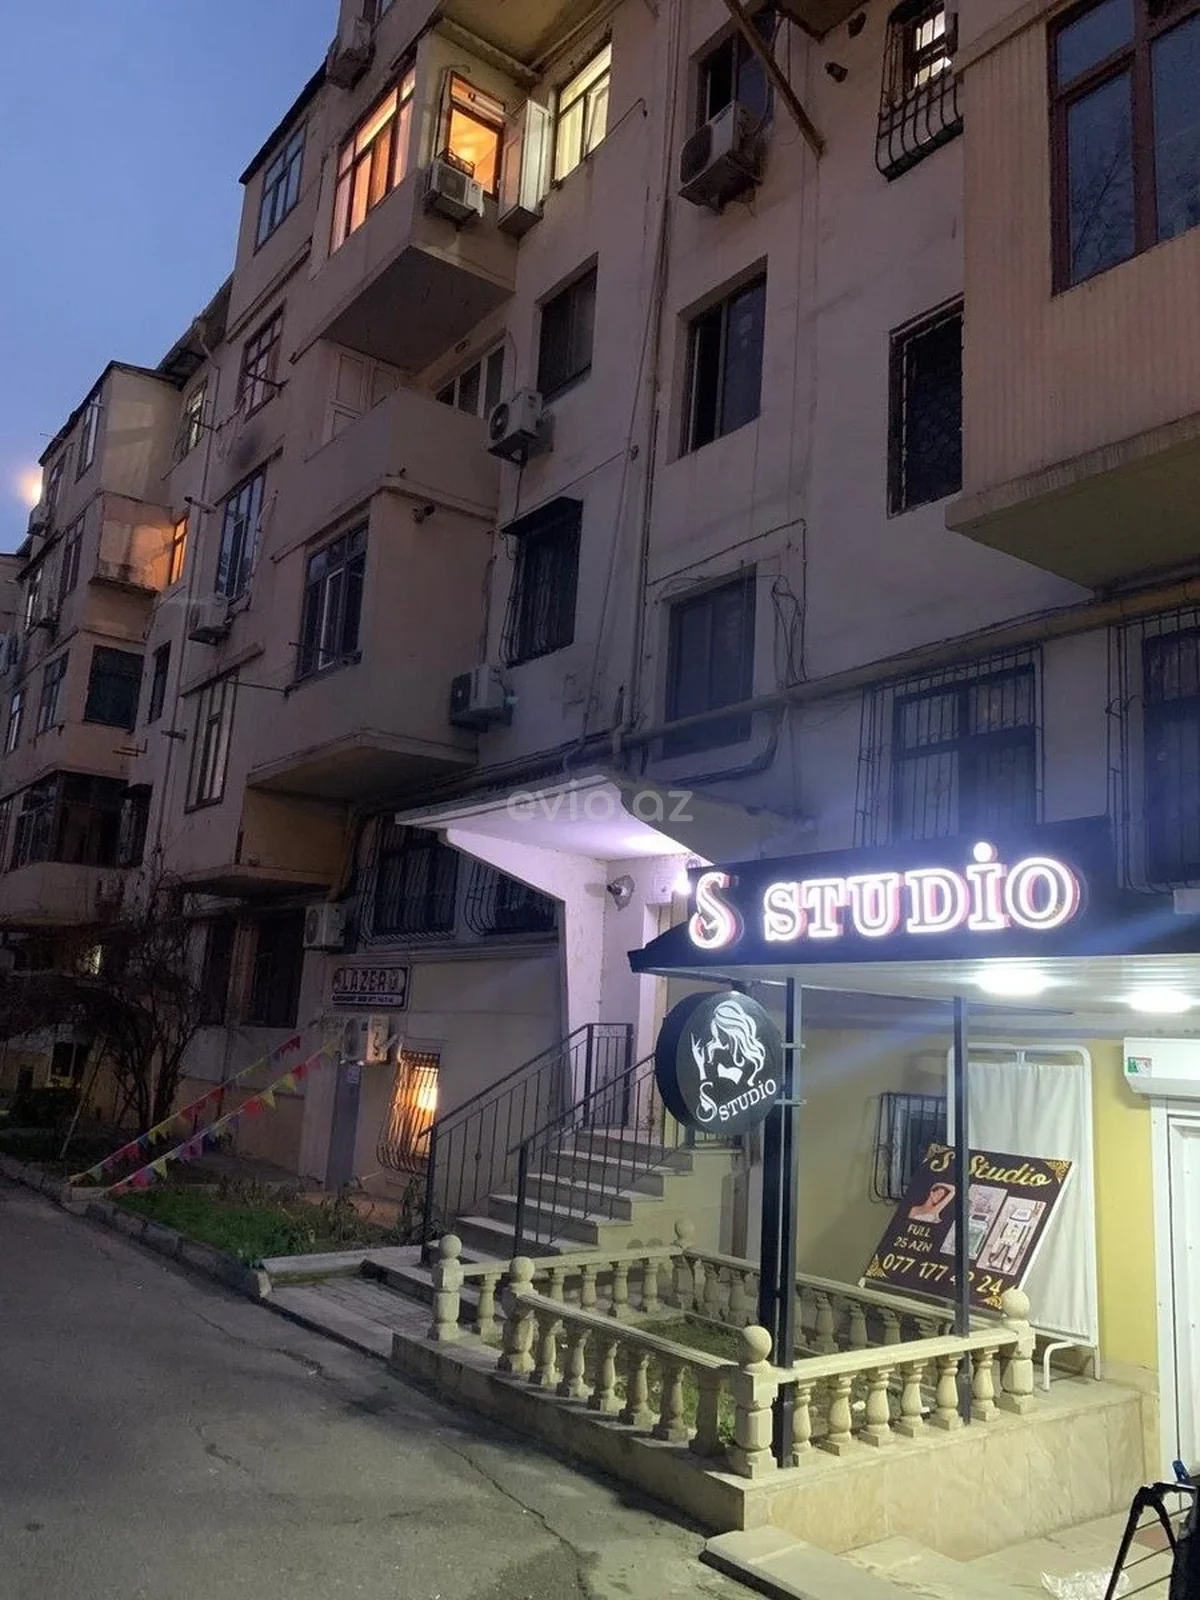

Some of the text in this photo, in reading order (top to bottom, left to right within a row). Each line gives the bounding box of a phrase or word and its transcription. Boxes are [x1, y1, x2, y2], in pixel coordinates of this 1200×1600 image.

[688, 871, 736, 949] S
[696, 1081, 718, 1122] S
[893, 1236, 933, 1252] 25 AZN
[907, 1223, 932, 1238] FULL
[882, 1252, 915, 1274] 077
[918, 1260, 949, 1281] 177
[976, 1275, 1004, 1296] 24
